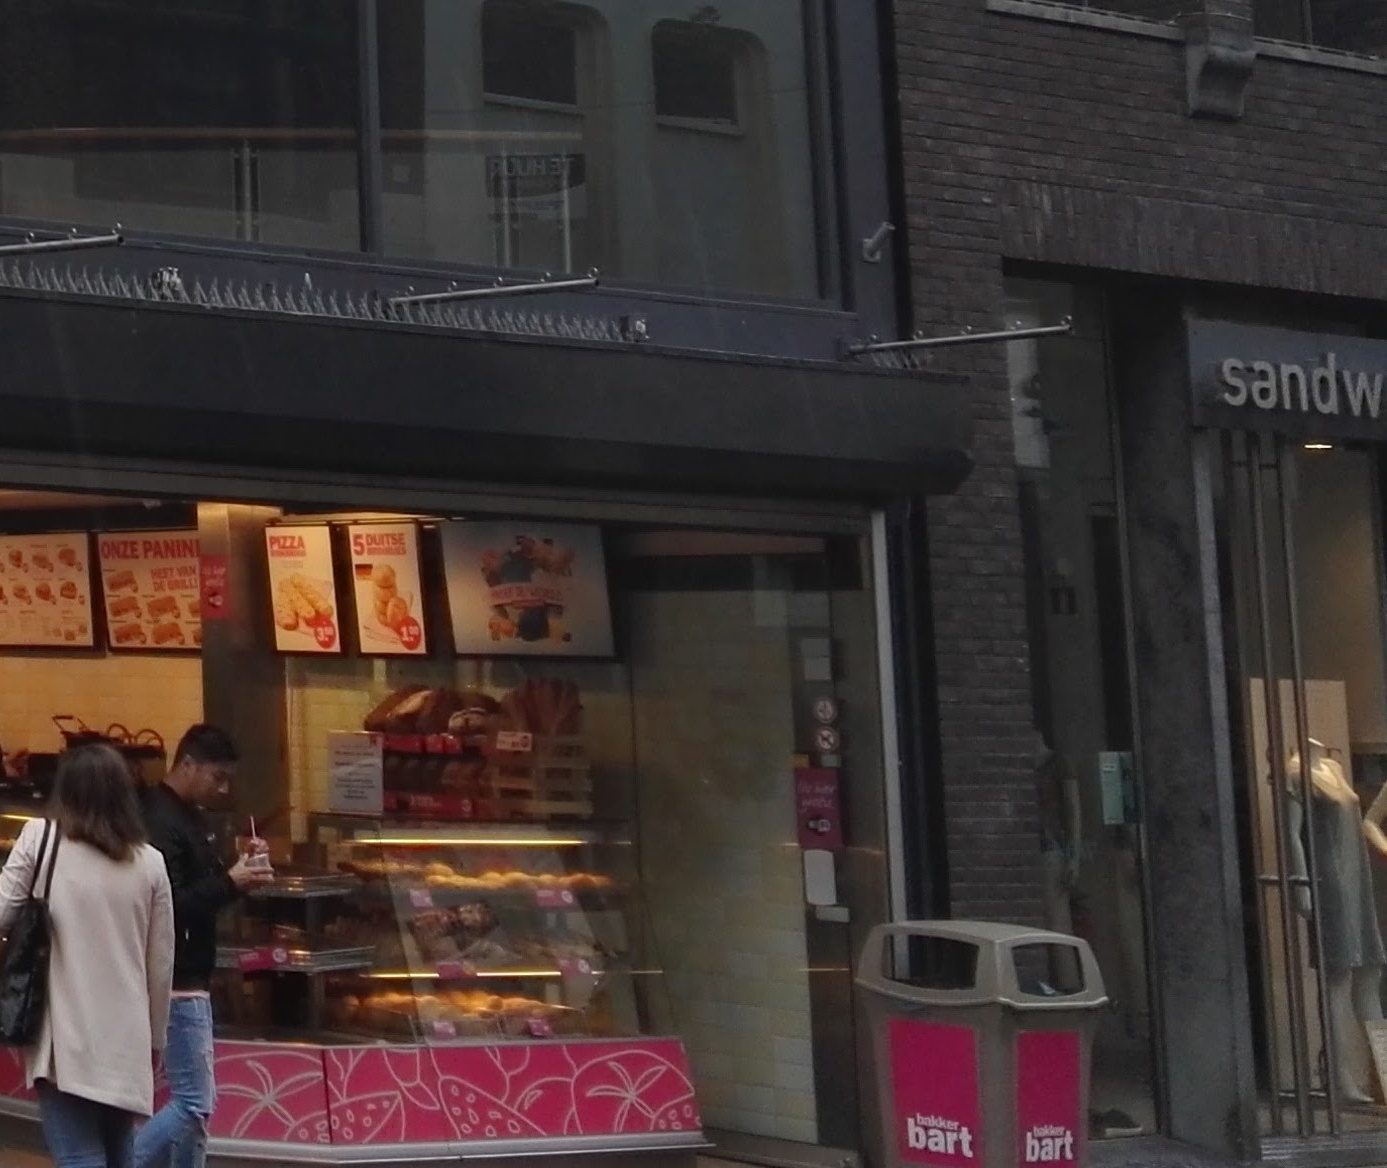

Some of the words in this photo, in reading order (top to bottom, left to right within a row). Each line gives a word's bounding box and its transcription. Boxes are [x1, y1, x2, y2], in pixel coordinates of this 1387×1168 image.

[1222, 352, 1384, 417] sandw
[101, 540, 139, 559] ONZE
[269, 536, 305, 549] PIZZA
[916, 1113, 959, 1131] bakker
[907, 1118, 973, 1158] bart
[1025, 1129, 1074, 1163] bart
